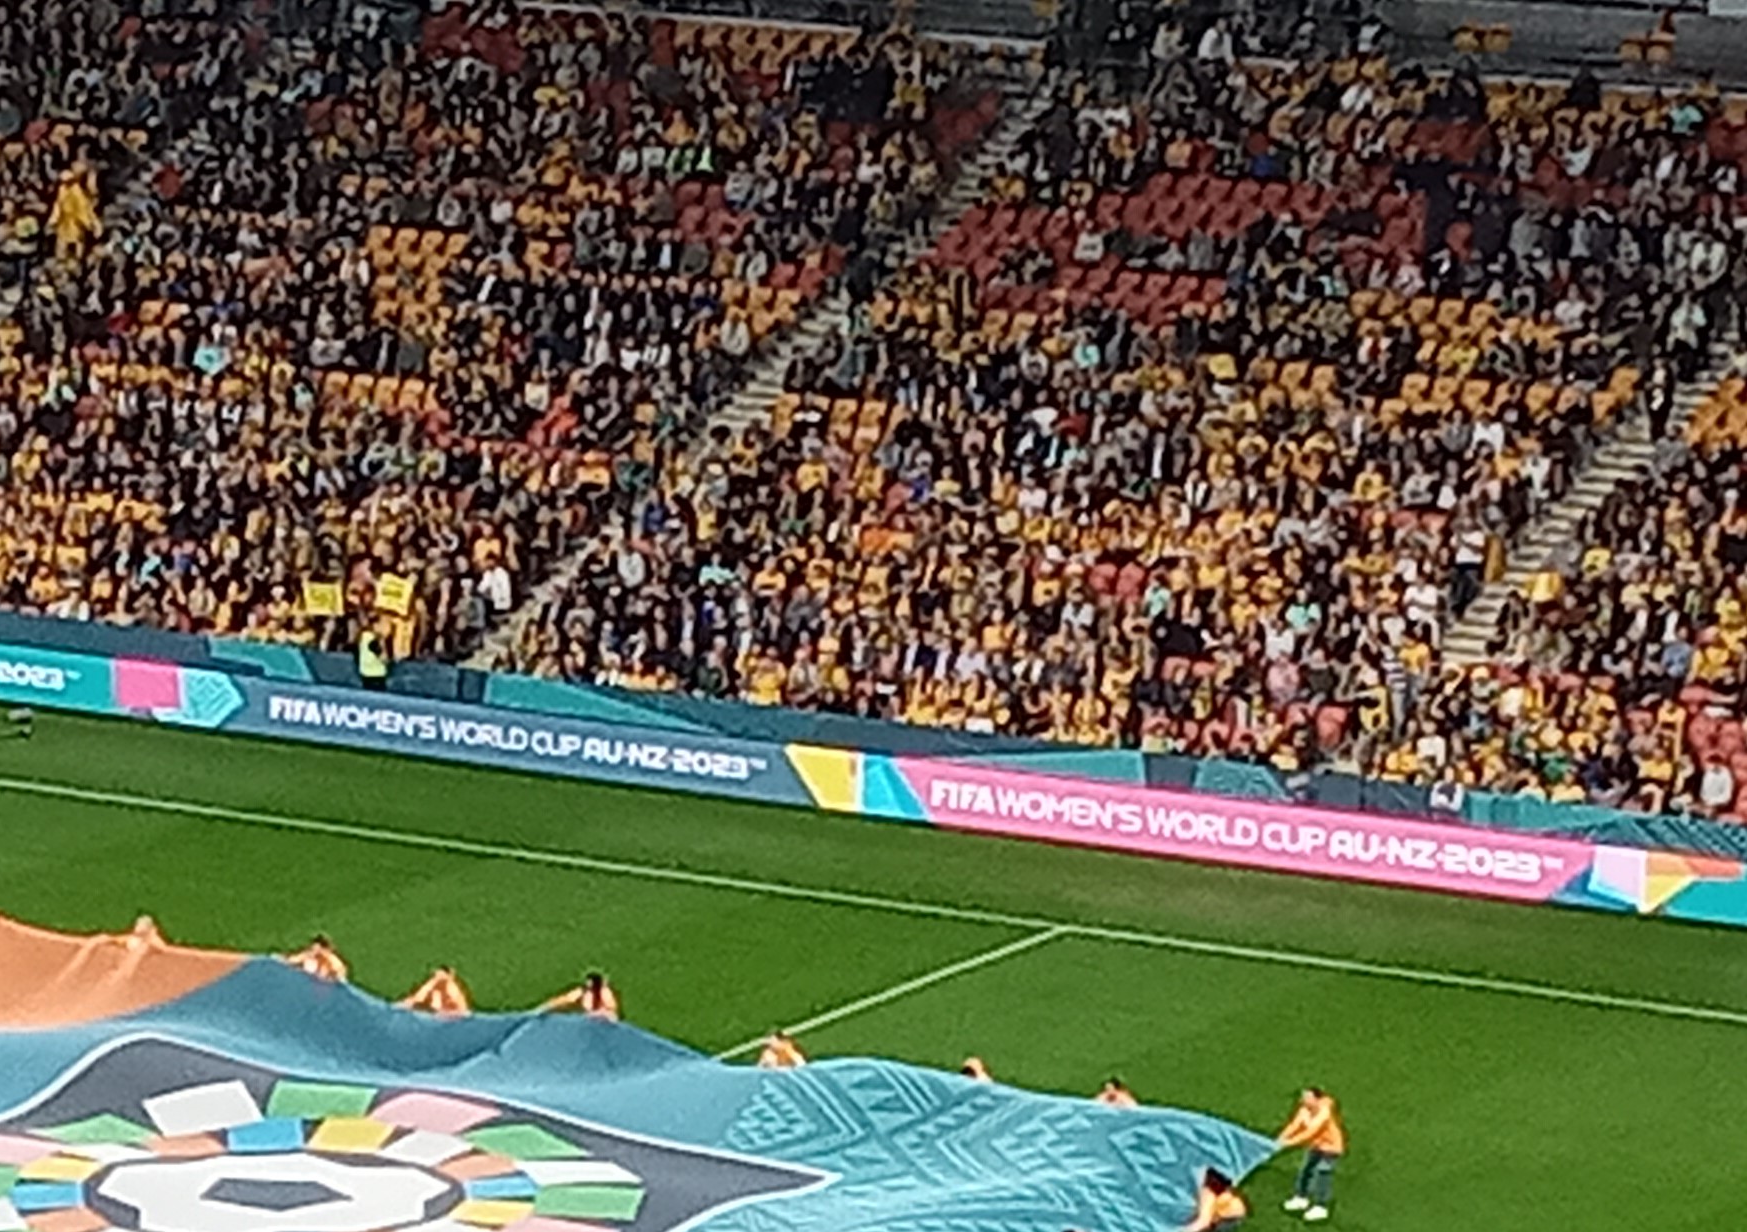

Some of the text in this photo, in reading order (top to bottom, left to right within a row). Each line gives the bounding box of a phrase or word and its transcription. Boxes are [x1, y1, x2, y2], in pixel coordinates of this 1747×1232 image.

[269, 695, 321, 724] FIFA
[322, 702, 437, 740] WOMEN'S
[438, 715, 529, 751] WORLD
[531, 730, 581, 757] CUP
[929, 779, 996, 814] FIFA
[996, 787, 1143, 833] WOMEN'S
[1145, 805, 1259, 848] WORLD
[1262, 821, 1327, 856] CUP
